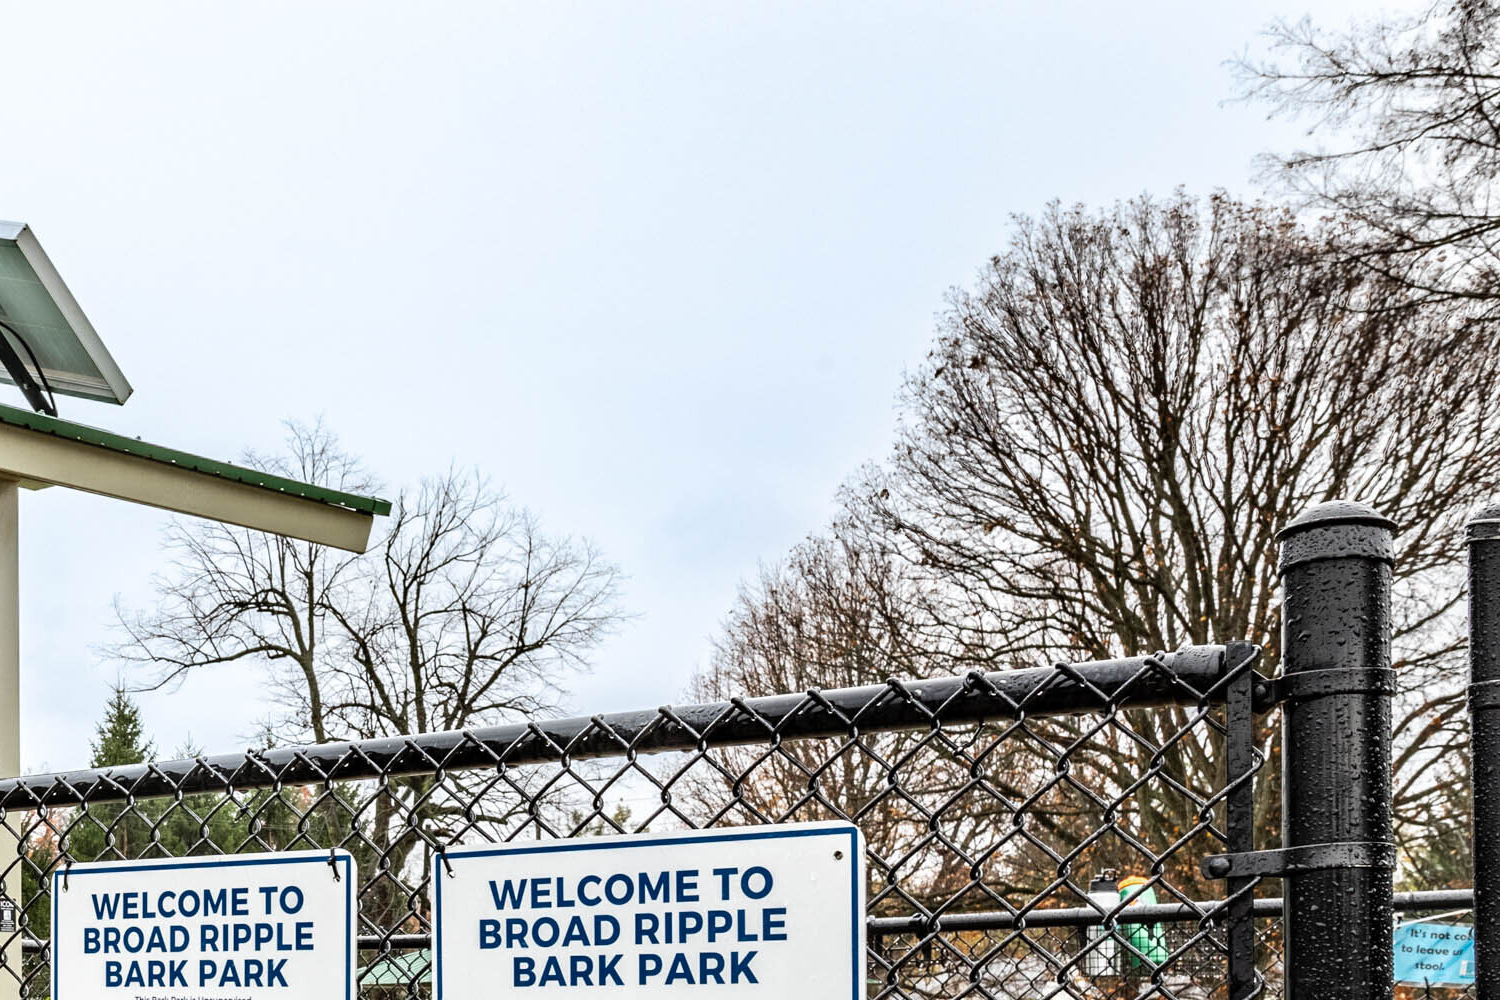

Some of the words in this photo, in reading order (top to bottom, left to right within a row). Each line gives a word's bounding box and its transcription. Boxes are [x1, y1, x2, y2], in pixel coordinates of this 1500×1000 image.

[92, 888, 248, 919] WELCOME
[259, 886, 303, 914] TO
[488, 869, 699, 909] WELCOME
[713, 866, 772, 900] TO
[84, 925, 189, 953] BROAD
[200, 922, 313, 951] RIPPLE
[477, 914, 619, 948] BROAD
[635, 908, 786, 944] RIPPLE
[1410, 928, 1427, 938] It's
[1430, 931, 1451, 940] not
[1401, 944, 1413, 953] to
[1416, 945, 1449, 956] leave
[105, 960, 187, 986] BARK
[199, 959, 288, 986] PARK
[513, 954, 624, 986] BARK
[639, 951, 758, 985] PARK
